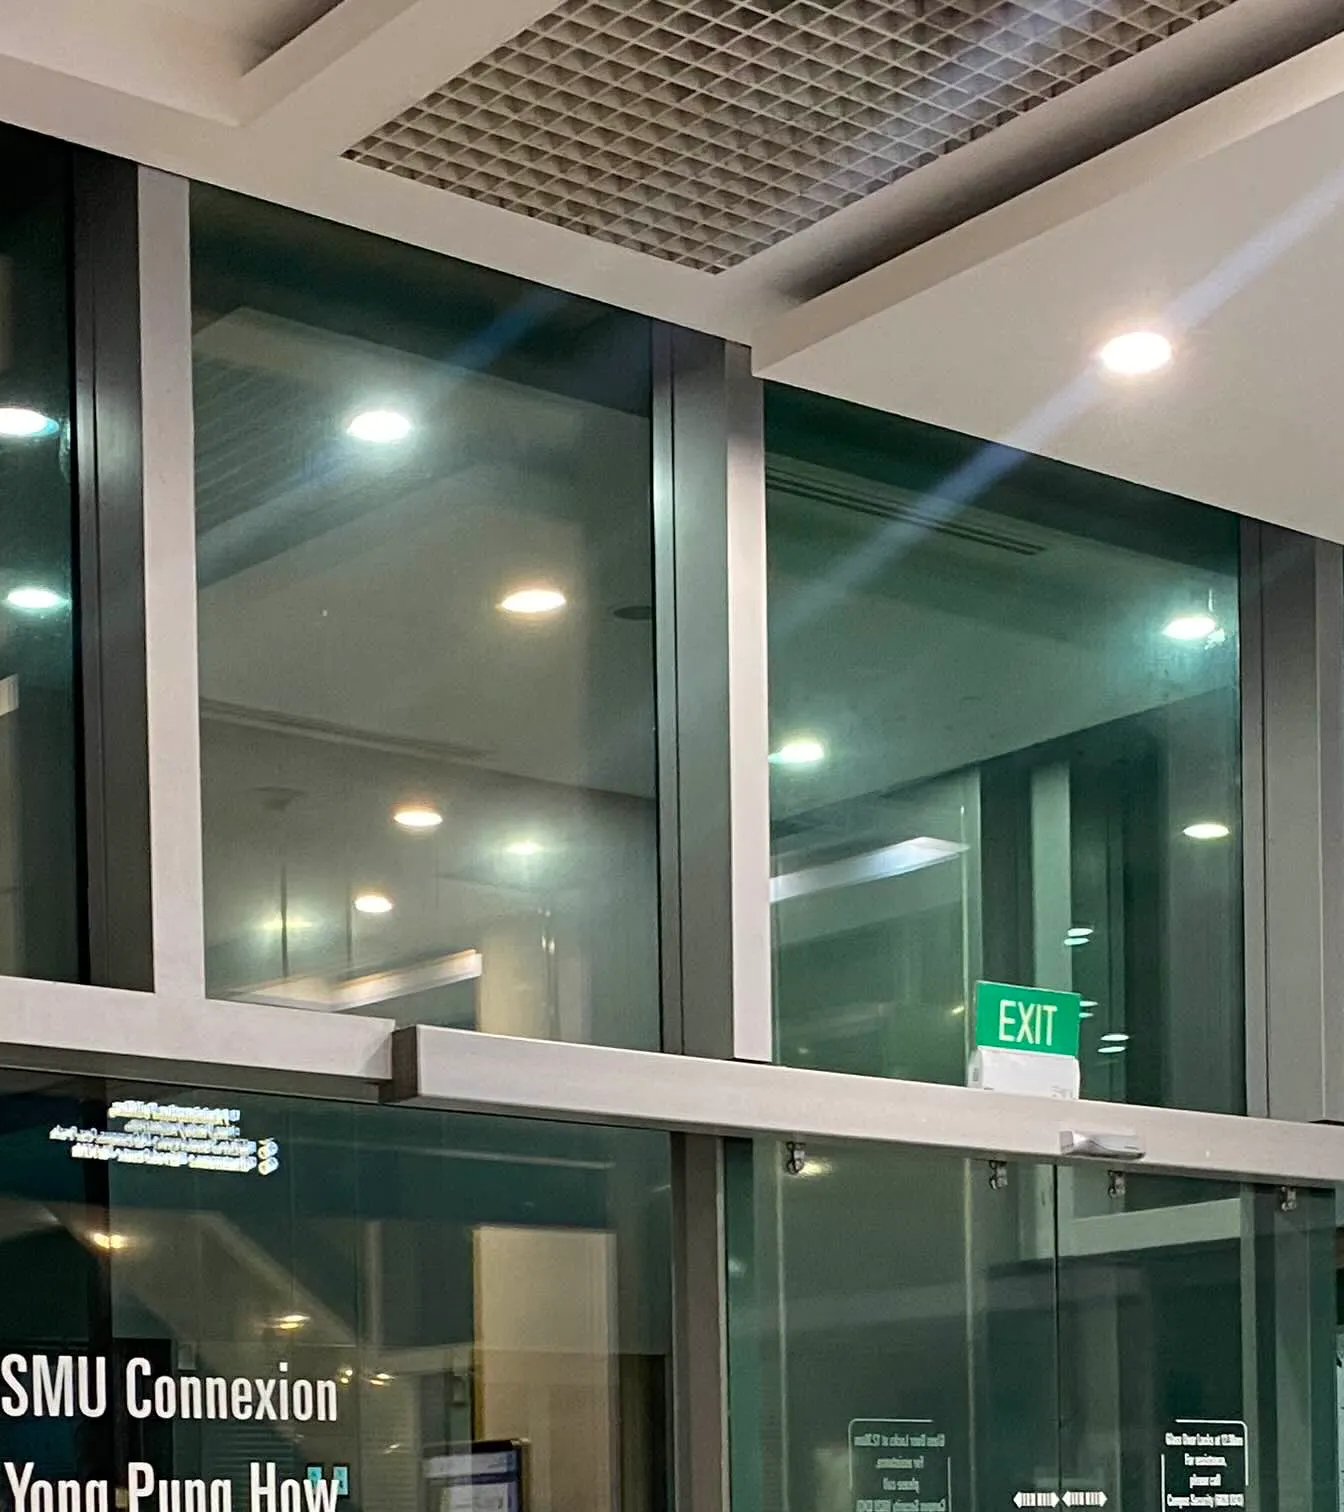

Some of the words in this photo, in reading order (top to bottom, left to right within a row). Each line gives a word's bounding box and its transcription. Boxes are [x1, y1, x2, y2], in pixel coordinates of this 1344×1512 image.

[999, 999, 1058, 1046] EXIT
[1, 1353, 106, 1418] SMU
[126, 1357, 337, 1421] Connexion
